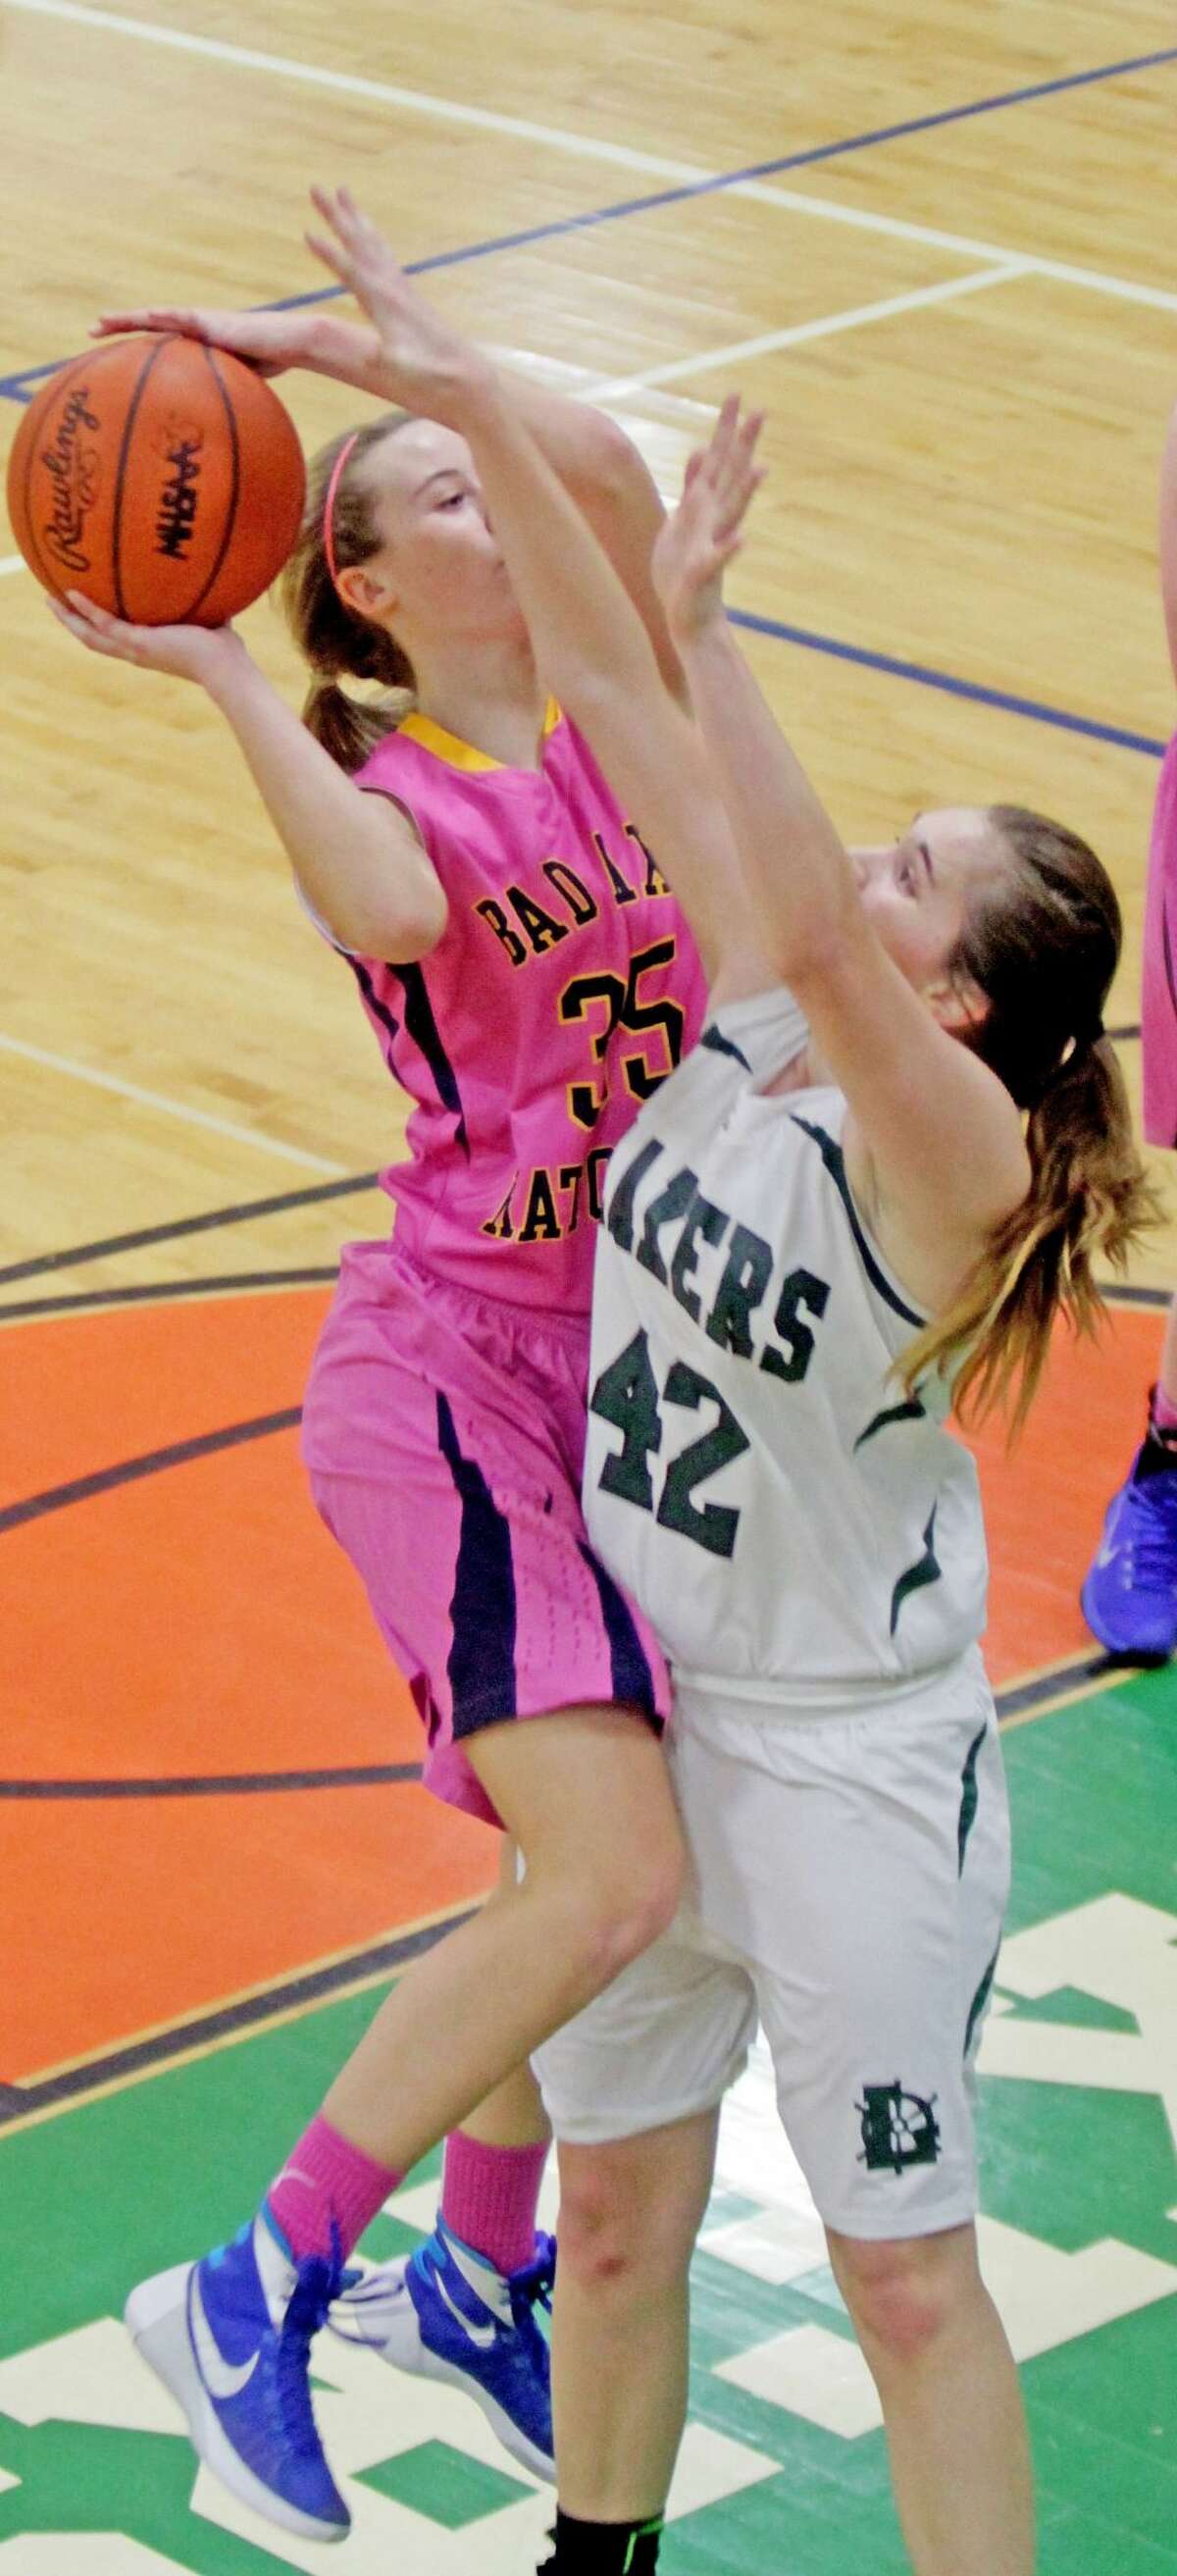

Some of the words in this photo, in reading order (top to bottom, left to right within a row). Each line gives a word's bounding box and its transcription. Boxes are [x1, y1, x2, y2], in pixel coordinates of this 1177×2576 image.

[43, 386, 100, 573] Rawlings
[472, 859, 598, 966] BAD
[558, 935, 686, 1132] 35
[588, 1326, 751, 1559] 42
